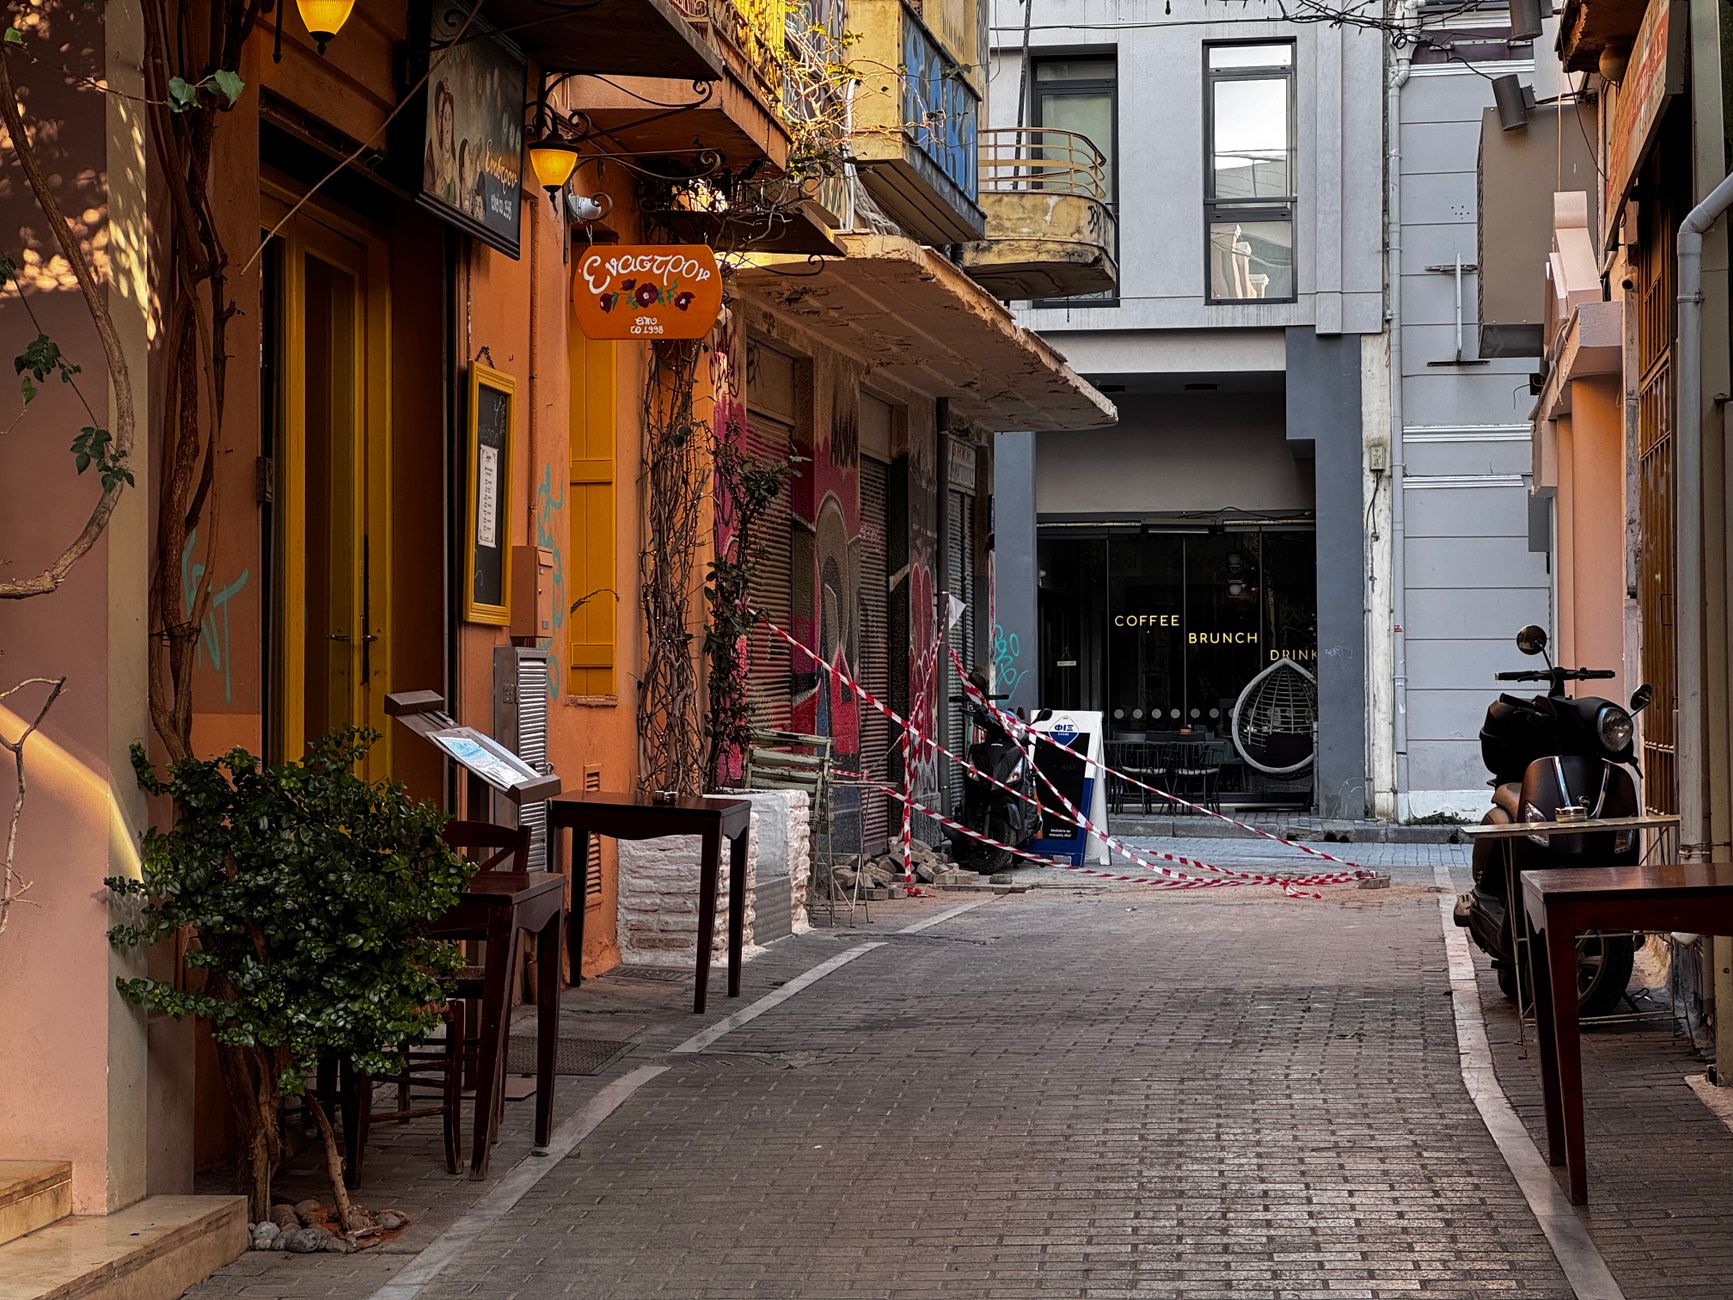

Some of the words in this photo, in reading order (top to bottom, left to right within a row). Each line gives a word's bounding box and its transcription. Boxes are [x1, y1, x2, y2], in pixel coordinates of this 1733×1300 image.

[643, 325, 664, 335] 1998
[1114, 615, 1180, 627] COFFEE
[1188, 632, 1258, 644] BRUNCH
[1054, 724, 1074, 732] ΦΙΞ
